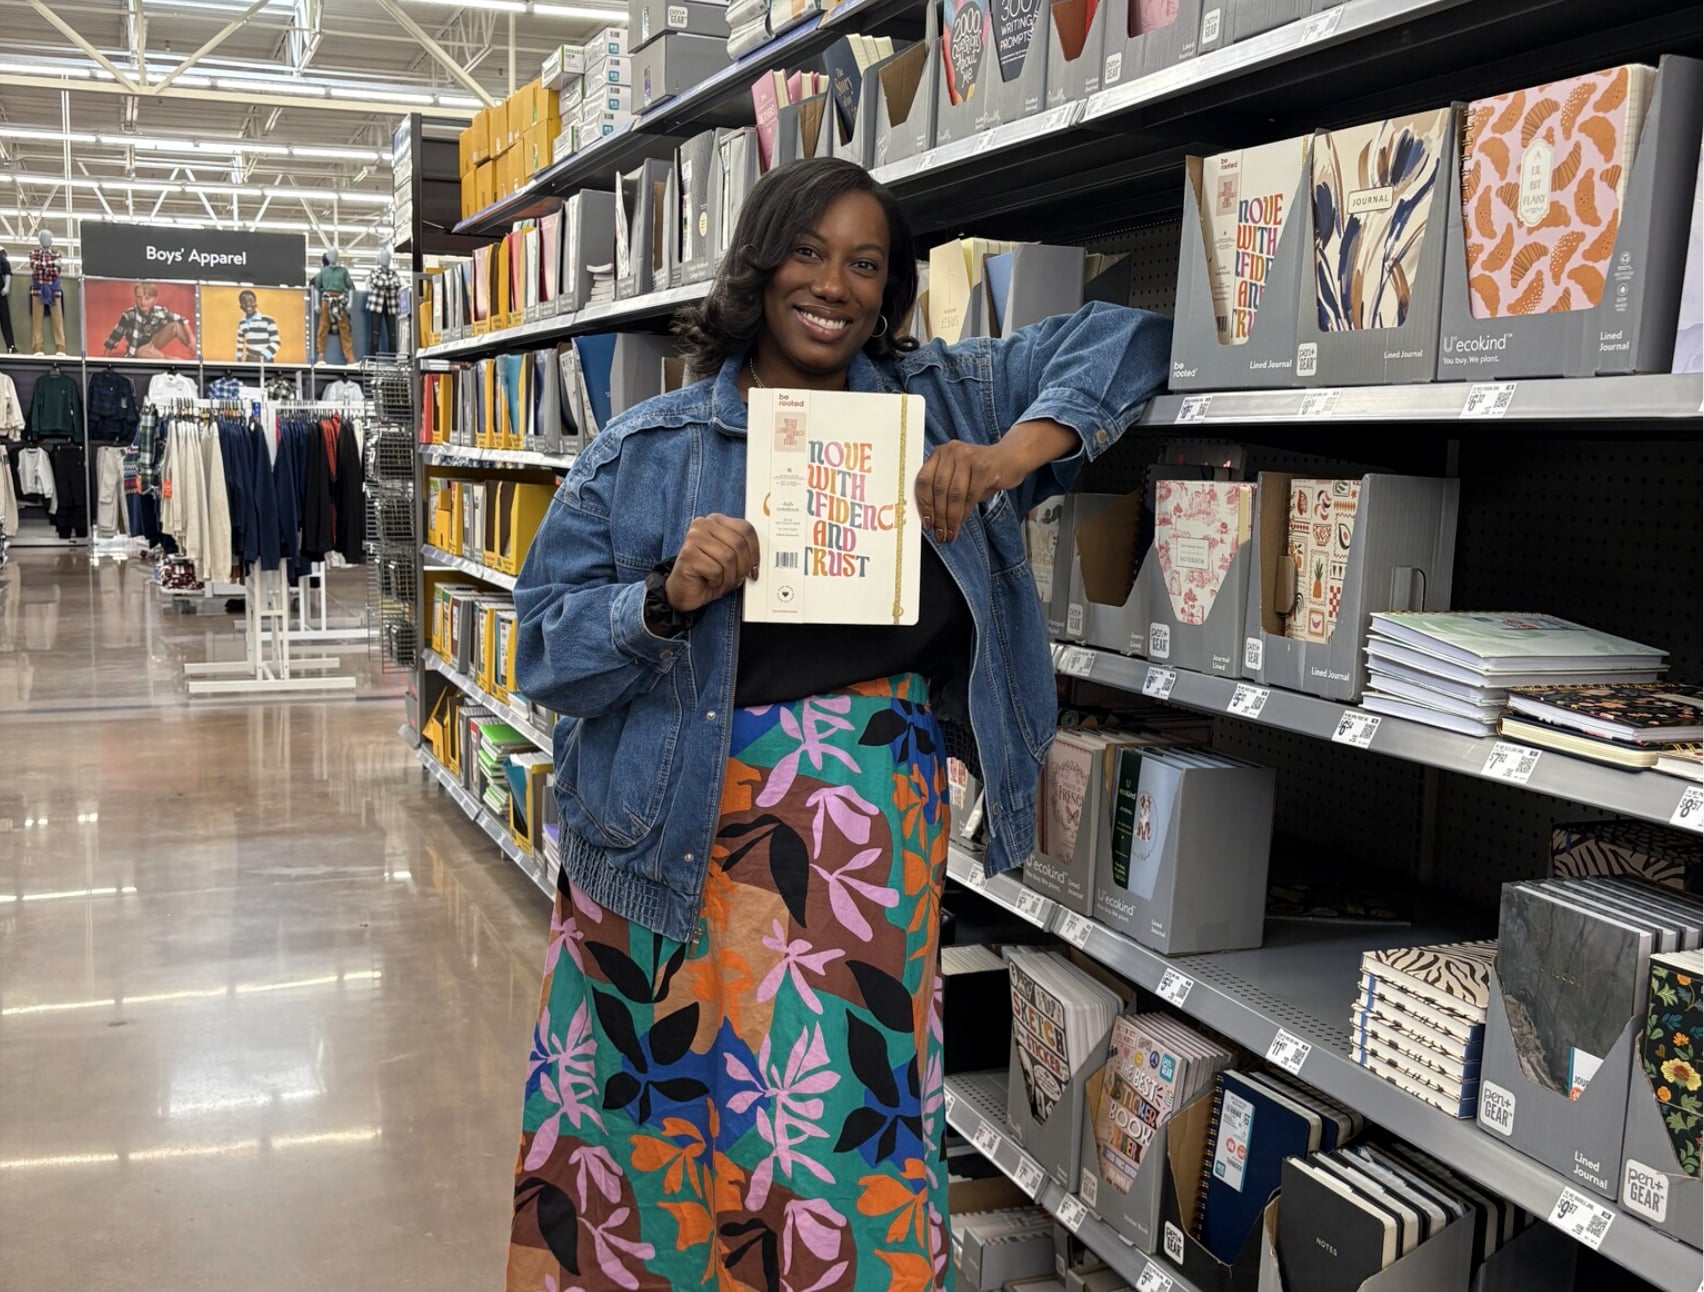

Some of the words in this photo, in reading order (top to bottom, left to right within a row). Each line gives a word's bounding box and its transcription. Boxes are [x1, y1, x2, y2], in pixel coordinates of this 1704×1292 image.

[953, 8, 982, 42] 2000
[1001, 14, 1033, 36] WRITING
[1000, 30, 1033, 51] PROMPTS
[1352, 194, 1389, 207] JOURNAL
[1236, 225, 1278, 257] WITH
[146, 246, 185, 265] Boys'
[189, 248, 247, 267] Apparel
[1599, 341, 1630, 352] Journal
[1600, 331, 1623, 342] Lined
[1249, 360, 1267, 370] Lined
[1268, 358, 1292, 370] Journal
[1384, 350, 1400, 359] Lined
[1401, 349, 1423, 359] Journal
[1443, 356, 1455, 365] You
[1174, 361, 1184, 370] be
[778, 400, 804, 408] rooted
[807, 464, 867, 503] WITH
[813, 519, 857, 553] AND
[1311, 666, 1329, 679] Lined
[1329, 669, 1351, 682] Journal
[1013, 991, 1067, 1058] SKETCH
[1133, 1070, 1158, 1103] BEST
[1483, 1088, 1512, 1108] pen+
[1485, 1101, 1509, 1127] GEAR
[1110, 1103, 1154, 1147] BOOK
[1574, 1150, 1600, 1172] Lined
[1573, 1164, 1608, 1189] Journal
[1628, 1167, 1664, 1190] pen+
[1630, 1183, 1660, 1212] GEAR
[1315, 1236, 1338, 1257] NOTES
